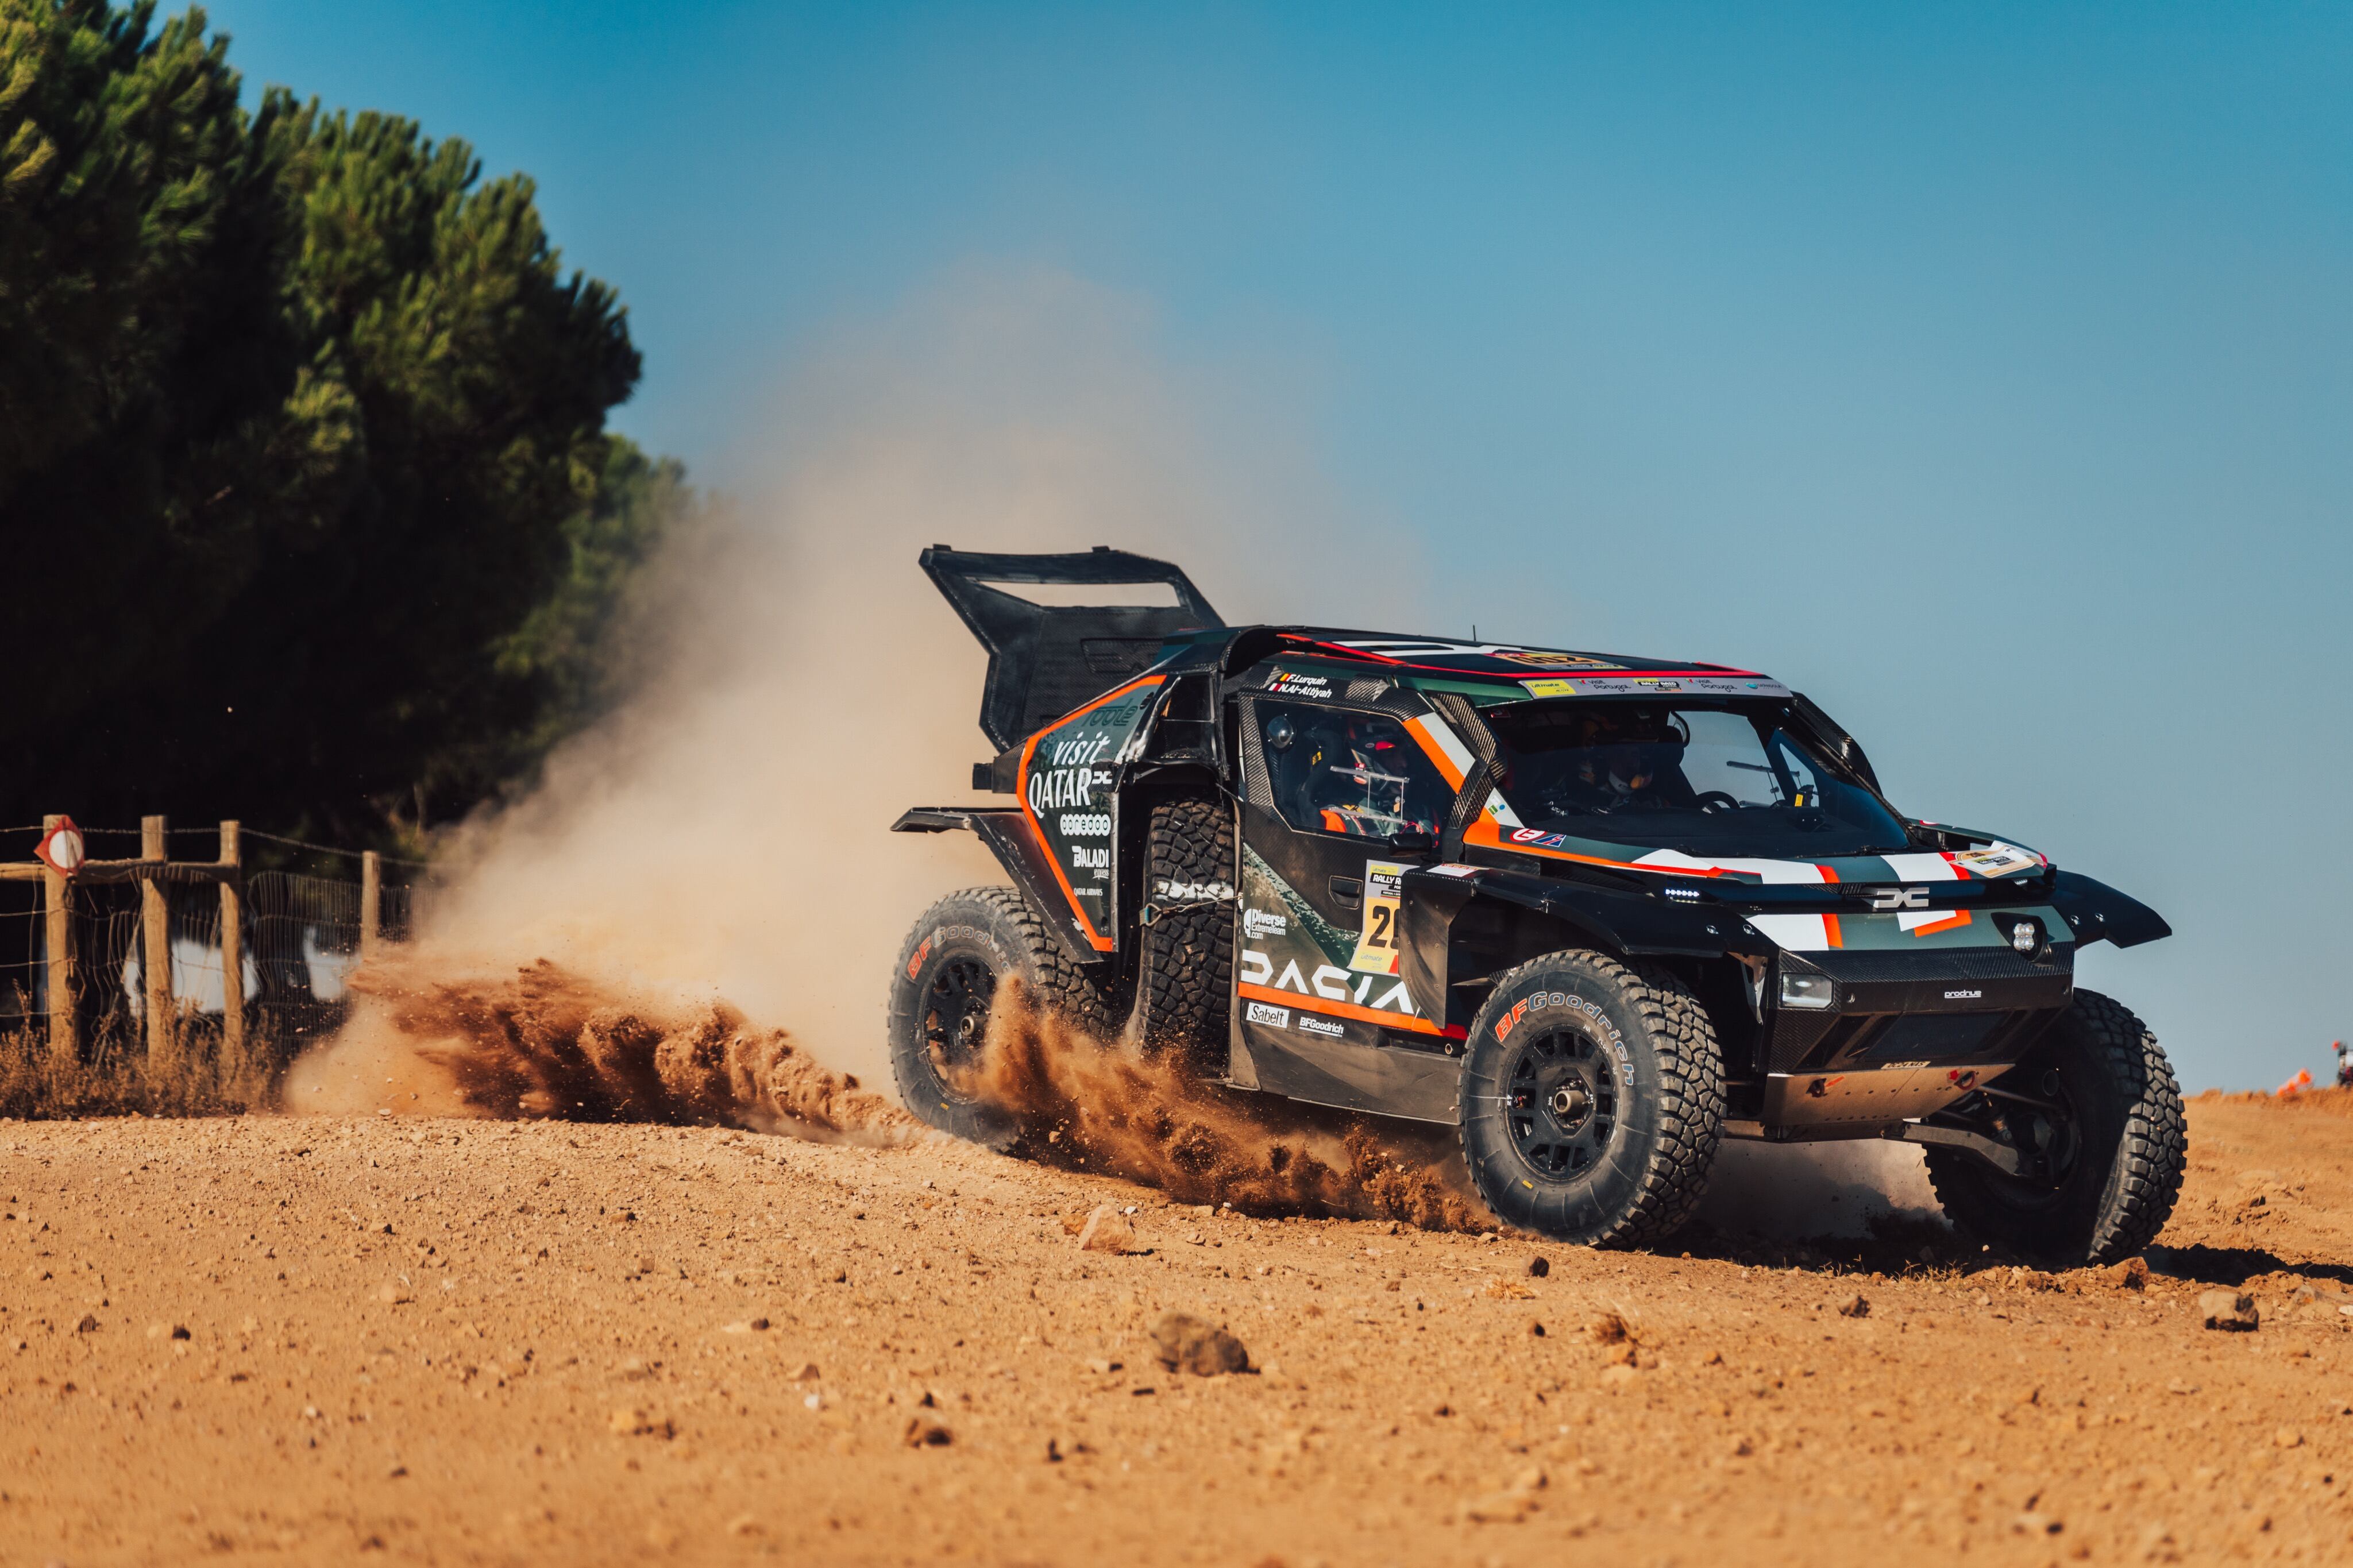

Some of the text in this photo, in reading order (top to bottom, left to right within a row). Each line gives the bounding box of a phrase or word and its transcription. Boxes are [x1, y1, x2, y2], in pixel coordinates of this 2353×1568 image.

[1286, 674, 1327, 685] F.Lurquin
[1278, 683, 1332, 698] N.Al-Attiyah
[1053, 731, 1111, 766] visit
[1029, 767, 1092, 818] QATAR
[1060, 814, 1111, 836] ooredoo
[1071, 845, 1109, 867] BALADI
[1372, 874, 1395, 884] RALLY
[1074, 887, 1103, 897] QATAR AIRWAYS
[1252, 909, 1286, 927] Diverse
[1251, 922, 1286, 936] ExtremeTeam
[1251, 932, 1263, 940] .com
[1241, 949, 1414, 1014] DACIA
[1252, 1005, 1284, 1025] Sabelt
[1299, 1017, 1344, 1034] BFGoodrich
[1495, 991, 1634, 1086] BFGoodrich
